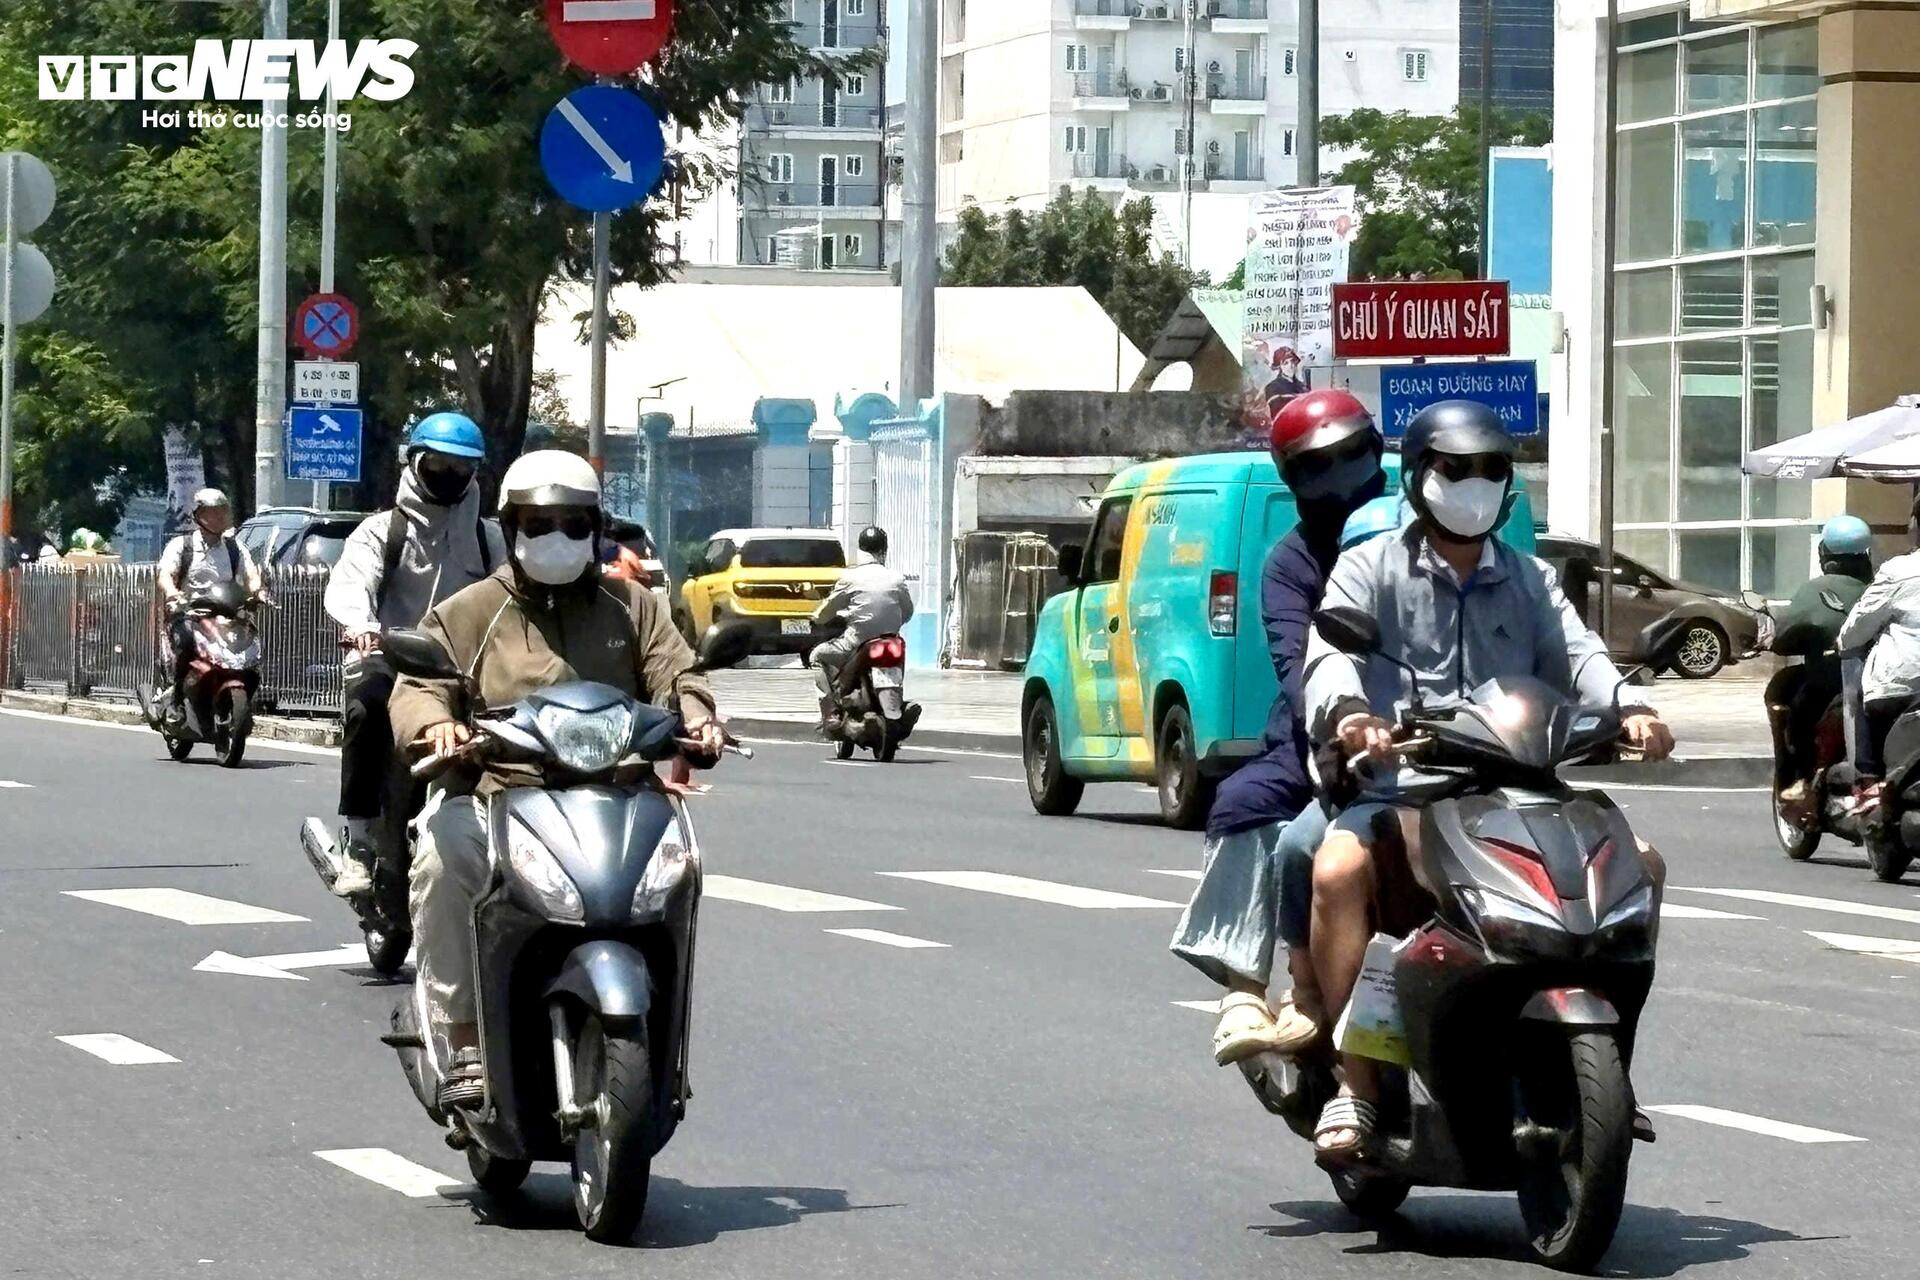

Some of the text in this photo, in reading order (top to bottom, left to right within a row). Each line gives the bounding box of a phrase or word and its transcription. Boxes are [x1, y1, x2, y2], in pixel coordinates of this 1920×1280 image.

[1339, 289, 1502, 341] CHÚ Ý QUAN SÁT
